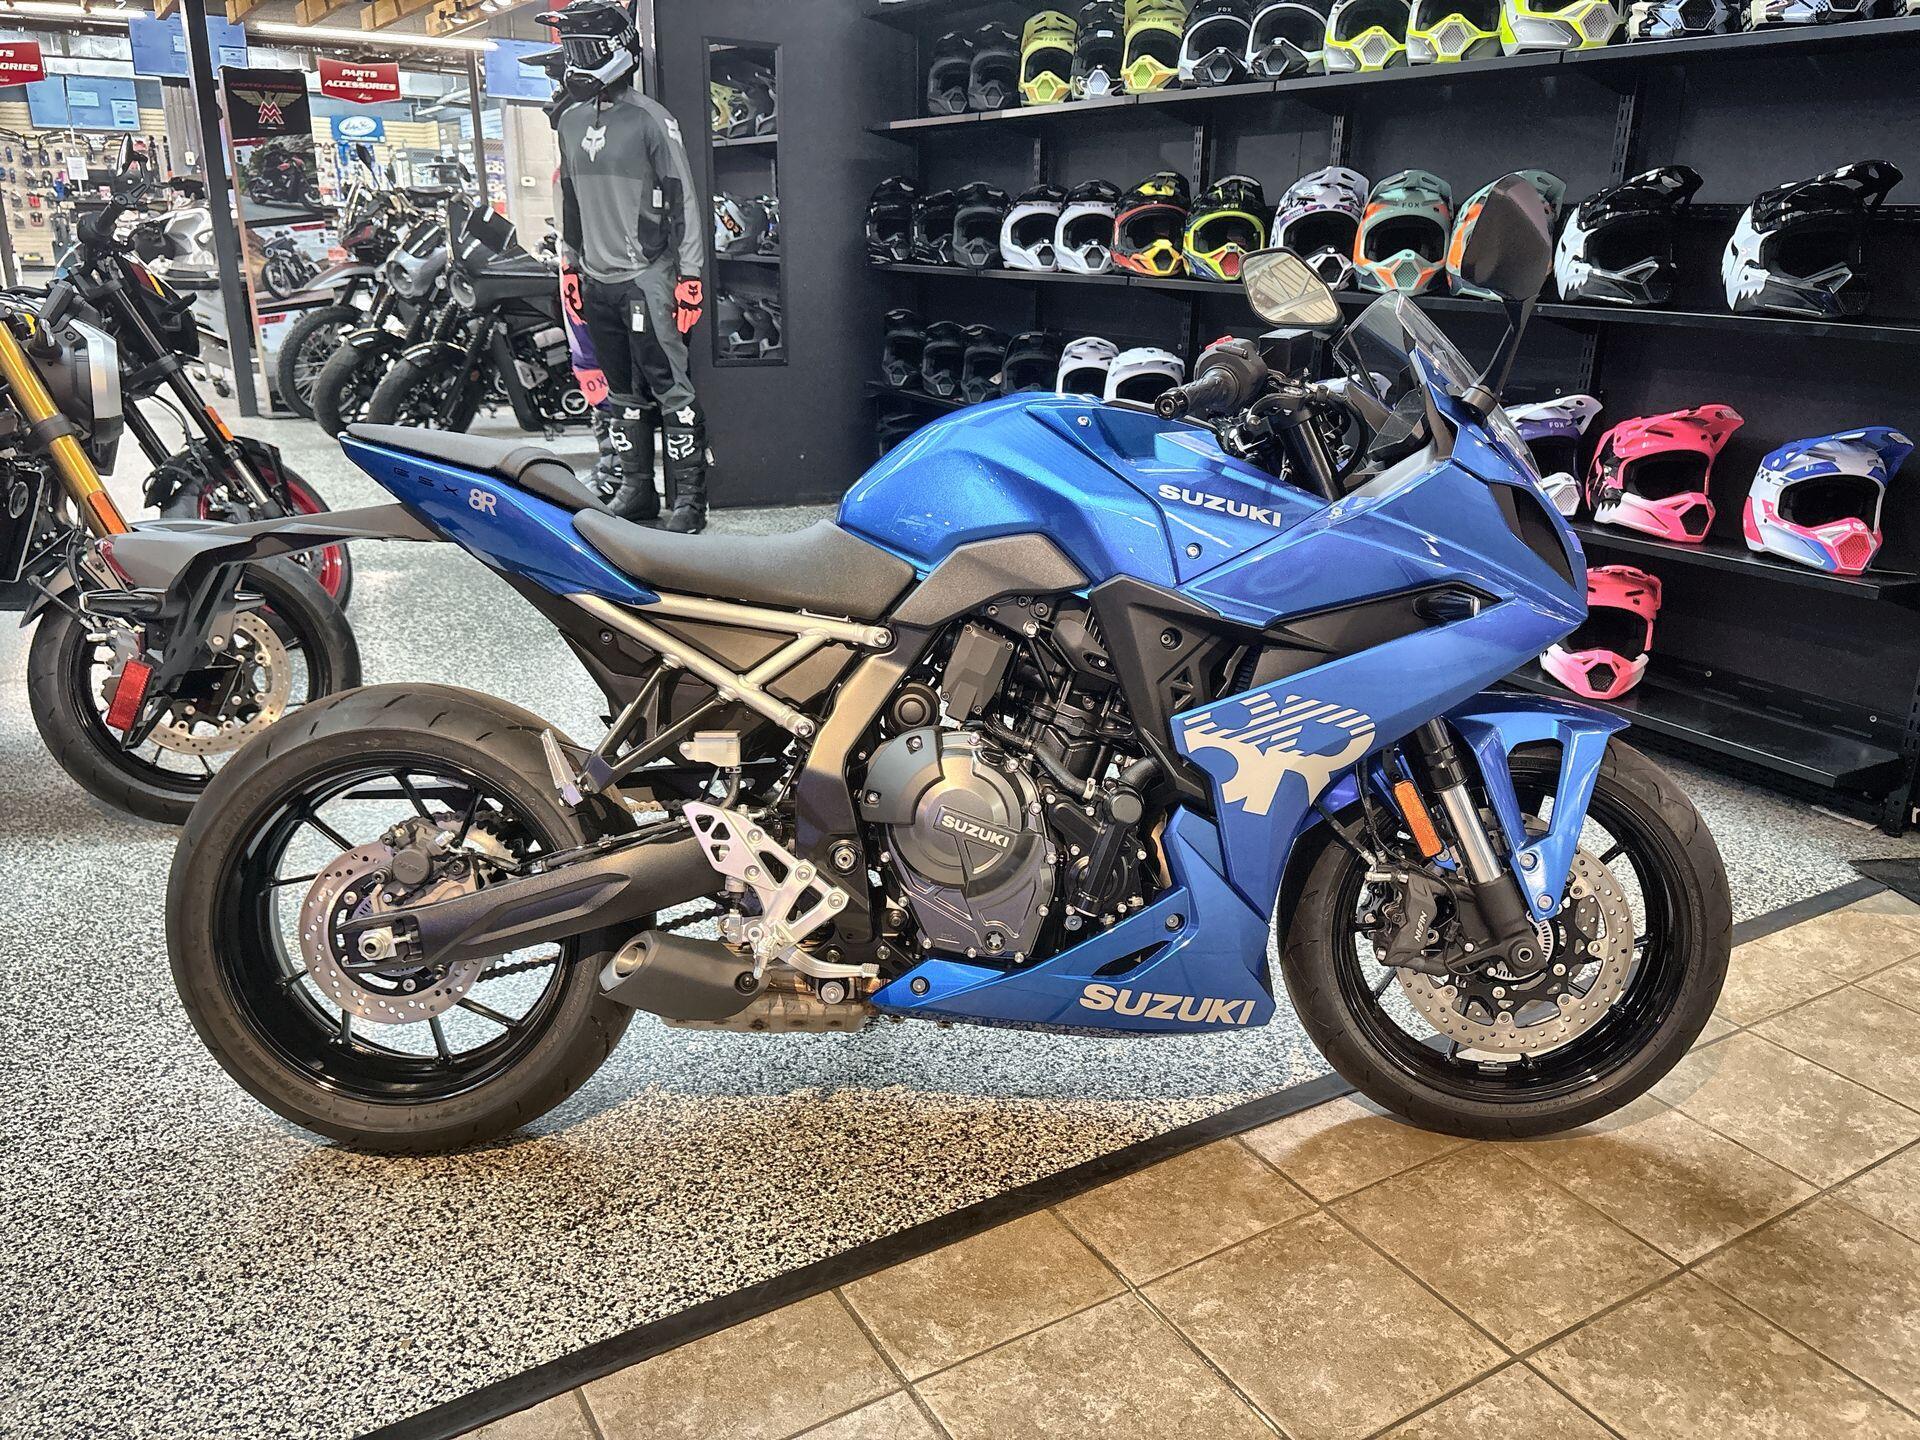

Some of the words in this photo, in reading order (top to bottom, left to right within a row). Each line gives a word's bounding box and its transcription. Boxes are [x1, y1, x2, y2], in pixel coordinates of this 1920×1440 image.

[324, 79, 397, 91] ACCESSORIES
[341, 69, 378, 78] PARTS
[1549, 421, 1565, 429] FOX
[468, 488, 497, 517] 8R
[1158, 484, 1282, 528] SUZUKI
[941, 815, 1010, 848] SUZUKI
[1079, 983, 1257, 1025] SUZUKI
